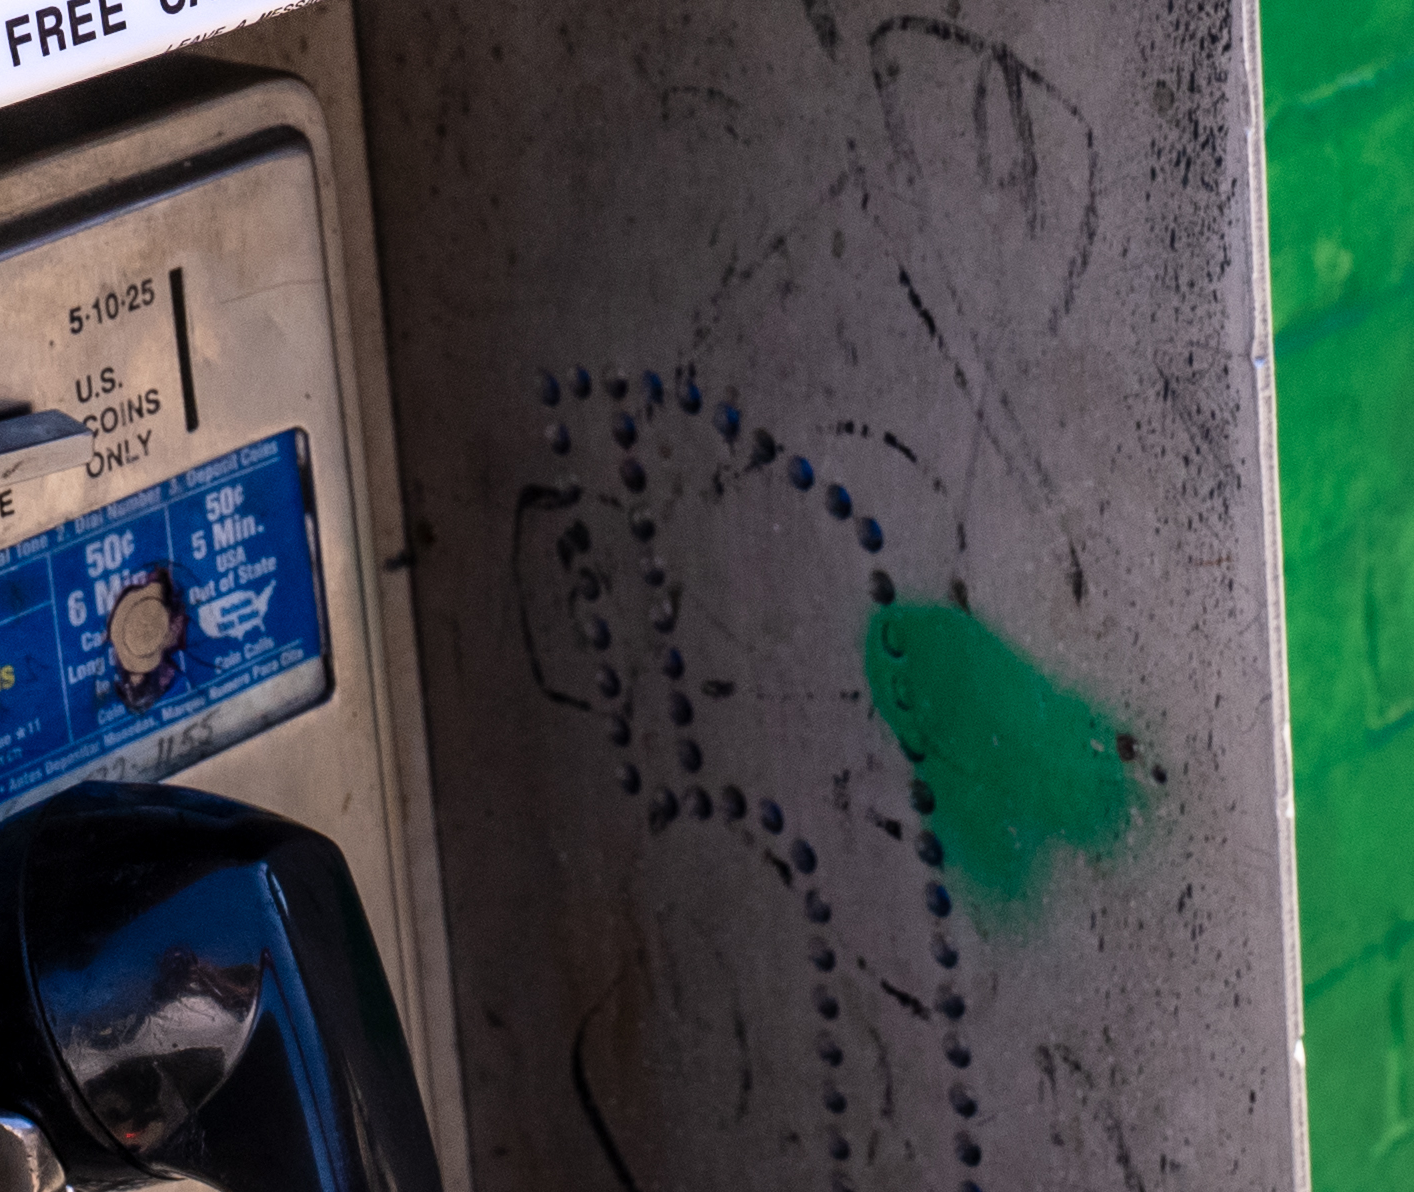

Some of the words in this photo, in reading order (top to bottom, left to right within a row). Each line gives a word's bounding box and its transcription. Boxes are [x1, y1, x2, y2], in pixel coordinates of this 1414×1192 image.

[165, 26, 227, 53] LEAVE
[75, 367, 124, 404] U.S.
[86, 429, 154, 481] ONLY
[15, 534, 49, 558] Tone
[74, 510, 104, 535] Dial
[106, 486, 162, 521] Number
[186, 452, 238, 488] Deposit
[239, 440, 278, 467] Coins
[205, 483, 245, 523] 50¢
[85, 528, 136, 578] 50¢
[190, 529, 207, 560] 5
[211, 513, 265, 551] Min.
[215, 545, 247, 573] USA
[188, 579, 216, 605] Out
[218, 569, 235, 593] of
[237, 556, 277, 584] State
[67, 589, 87, 628] 6
[67, 656, 106, 685] Long
[214, 651, 242, 674] Coin
[243, 636, 275, 660] Calls
[9, 768, 43, 793] Antes
[44, 741, 100, 775] Depositar
[103, 716, 159, 747] Monedas,
[252, 659, 280, 680] Para
